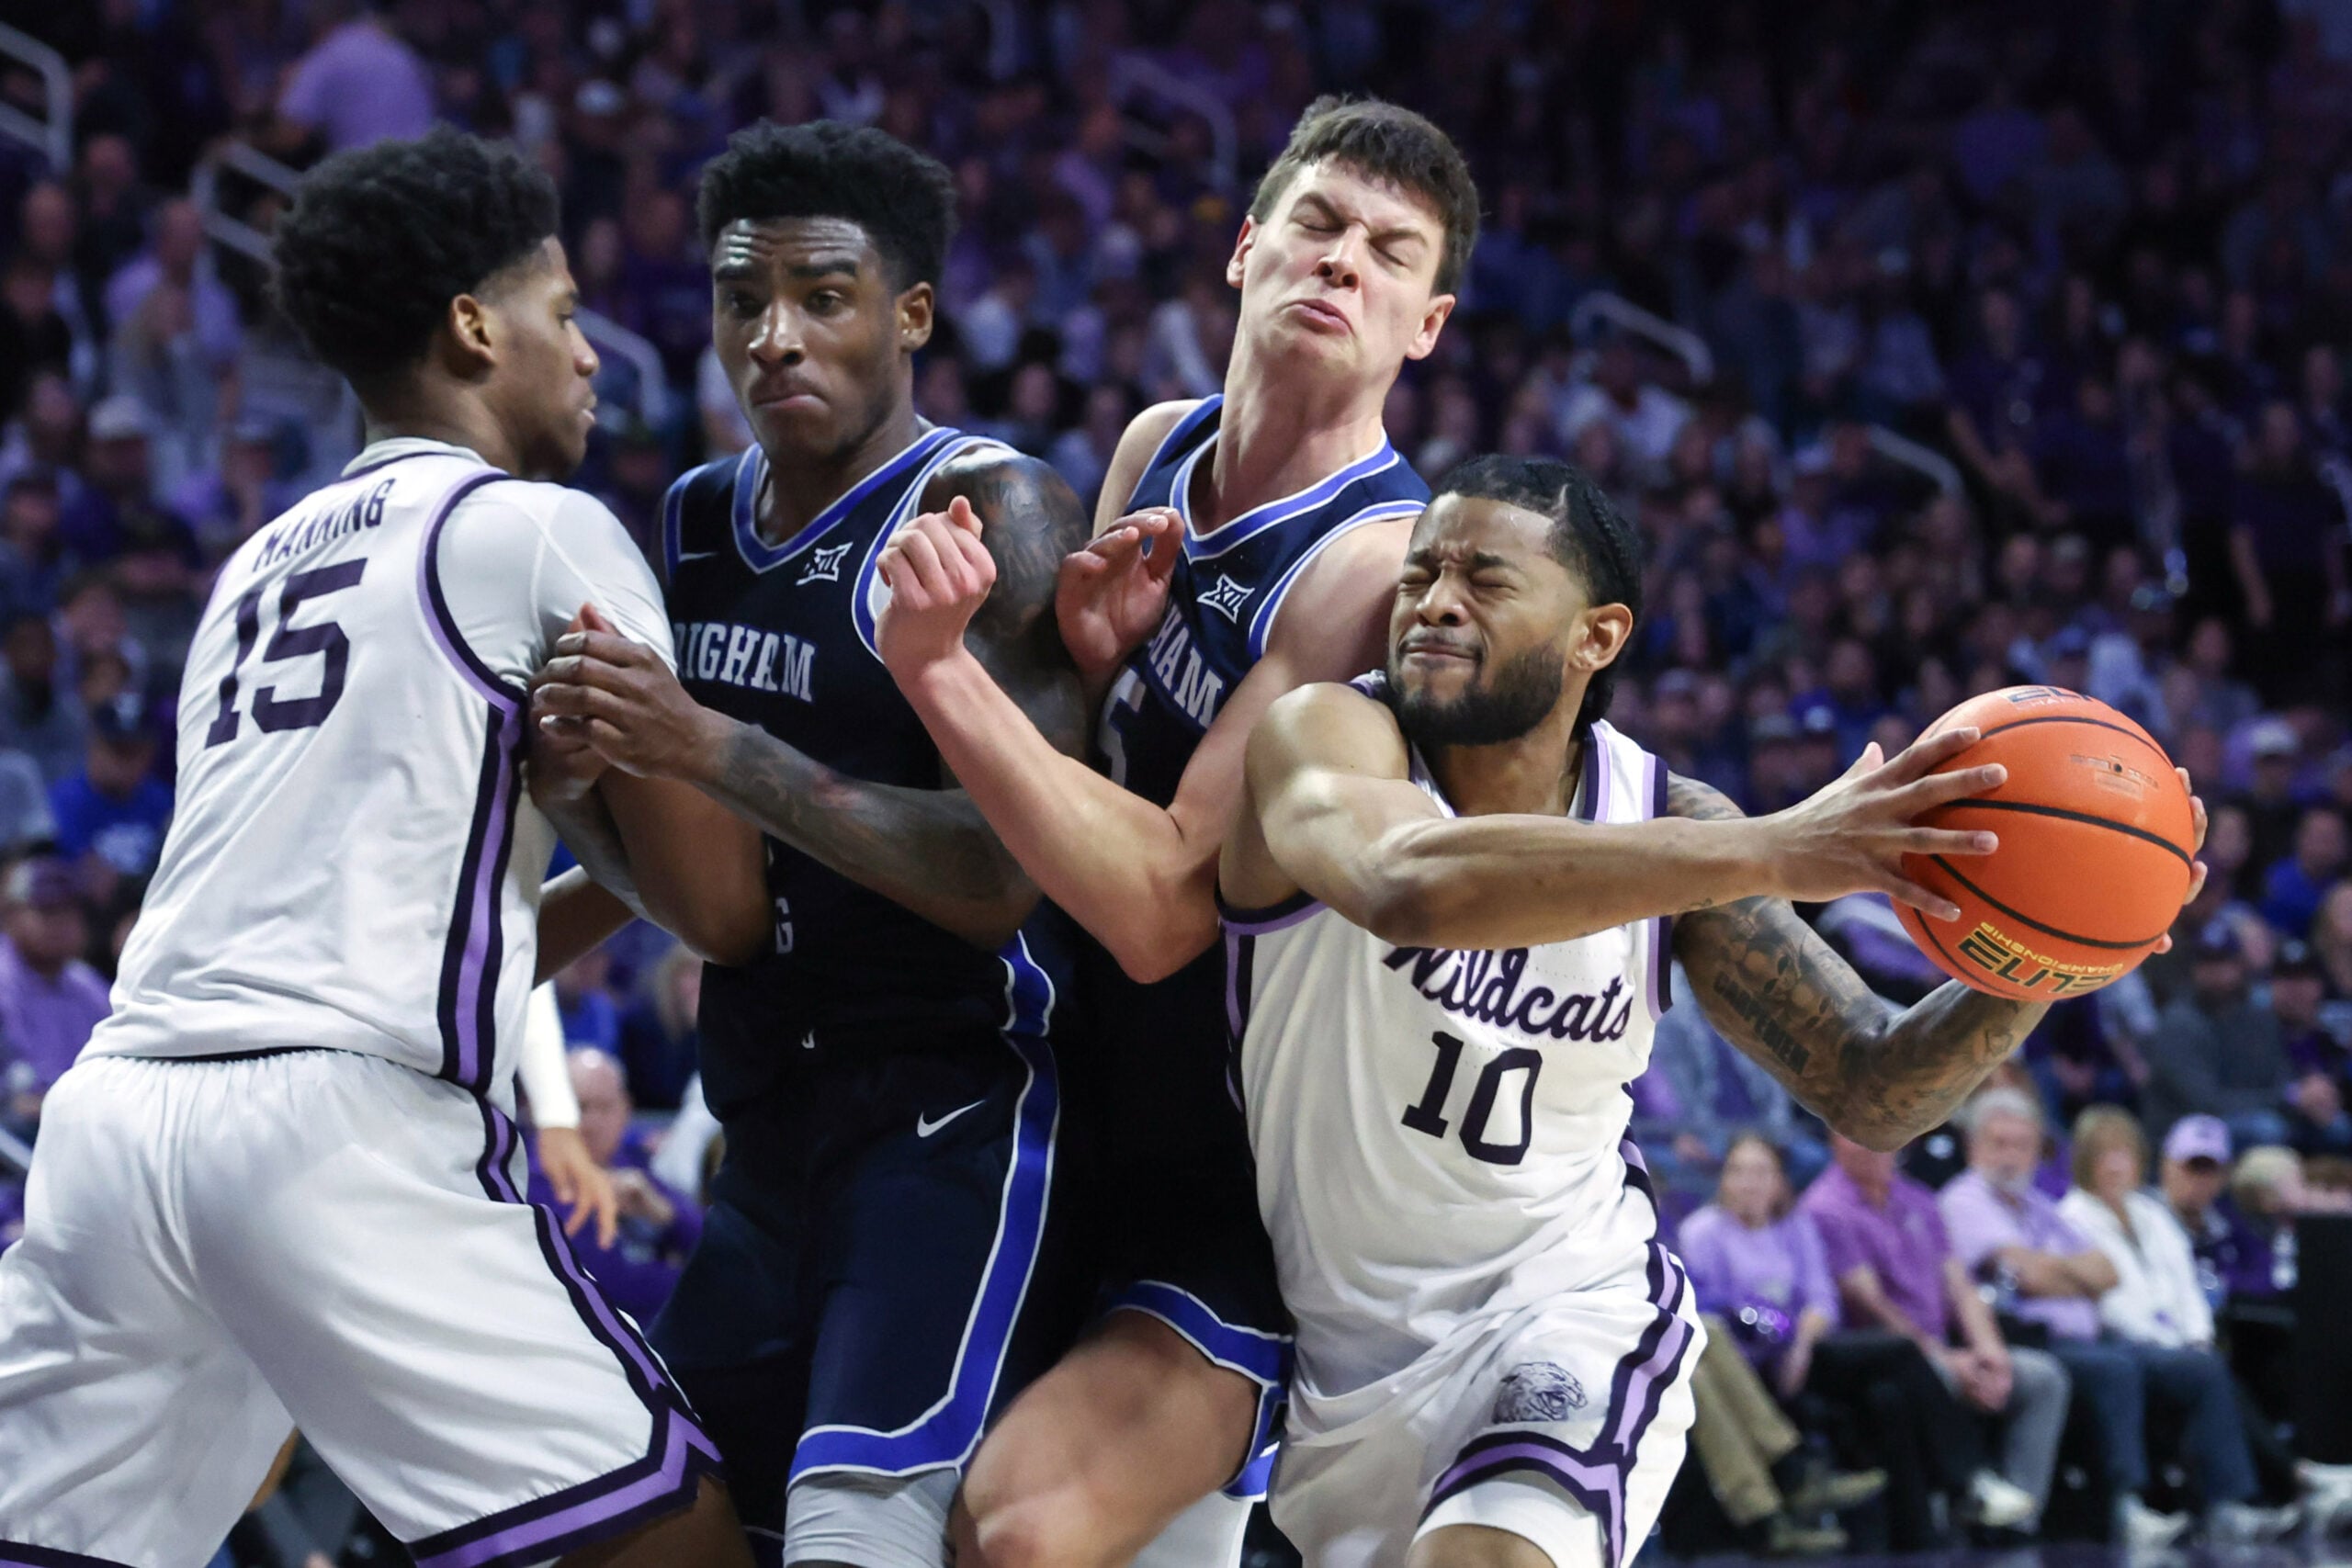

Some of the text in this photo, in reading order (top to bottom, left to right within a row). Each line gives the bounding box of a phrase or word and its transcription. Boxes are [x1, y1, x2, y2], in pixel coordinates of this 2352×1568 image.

[252, 477, 396, 573] MANNING
[204, 558, 368, 750] 15
[1148, 599, 1225, 729] HAM
[1955, 928, 2113, 995] ELITE
[1978, 919, 2124, 976] CHAMPIONSHIP
[1400, 1031, 1543, 1166] 10
